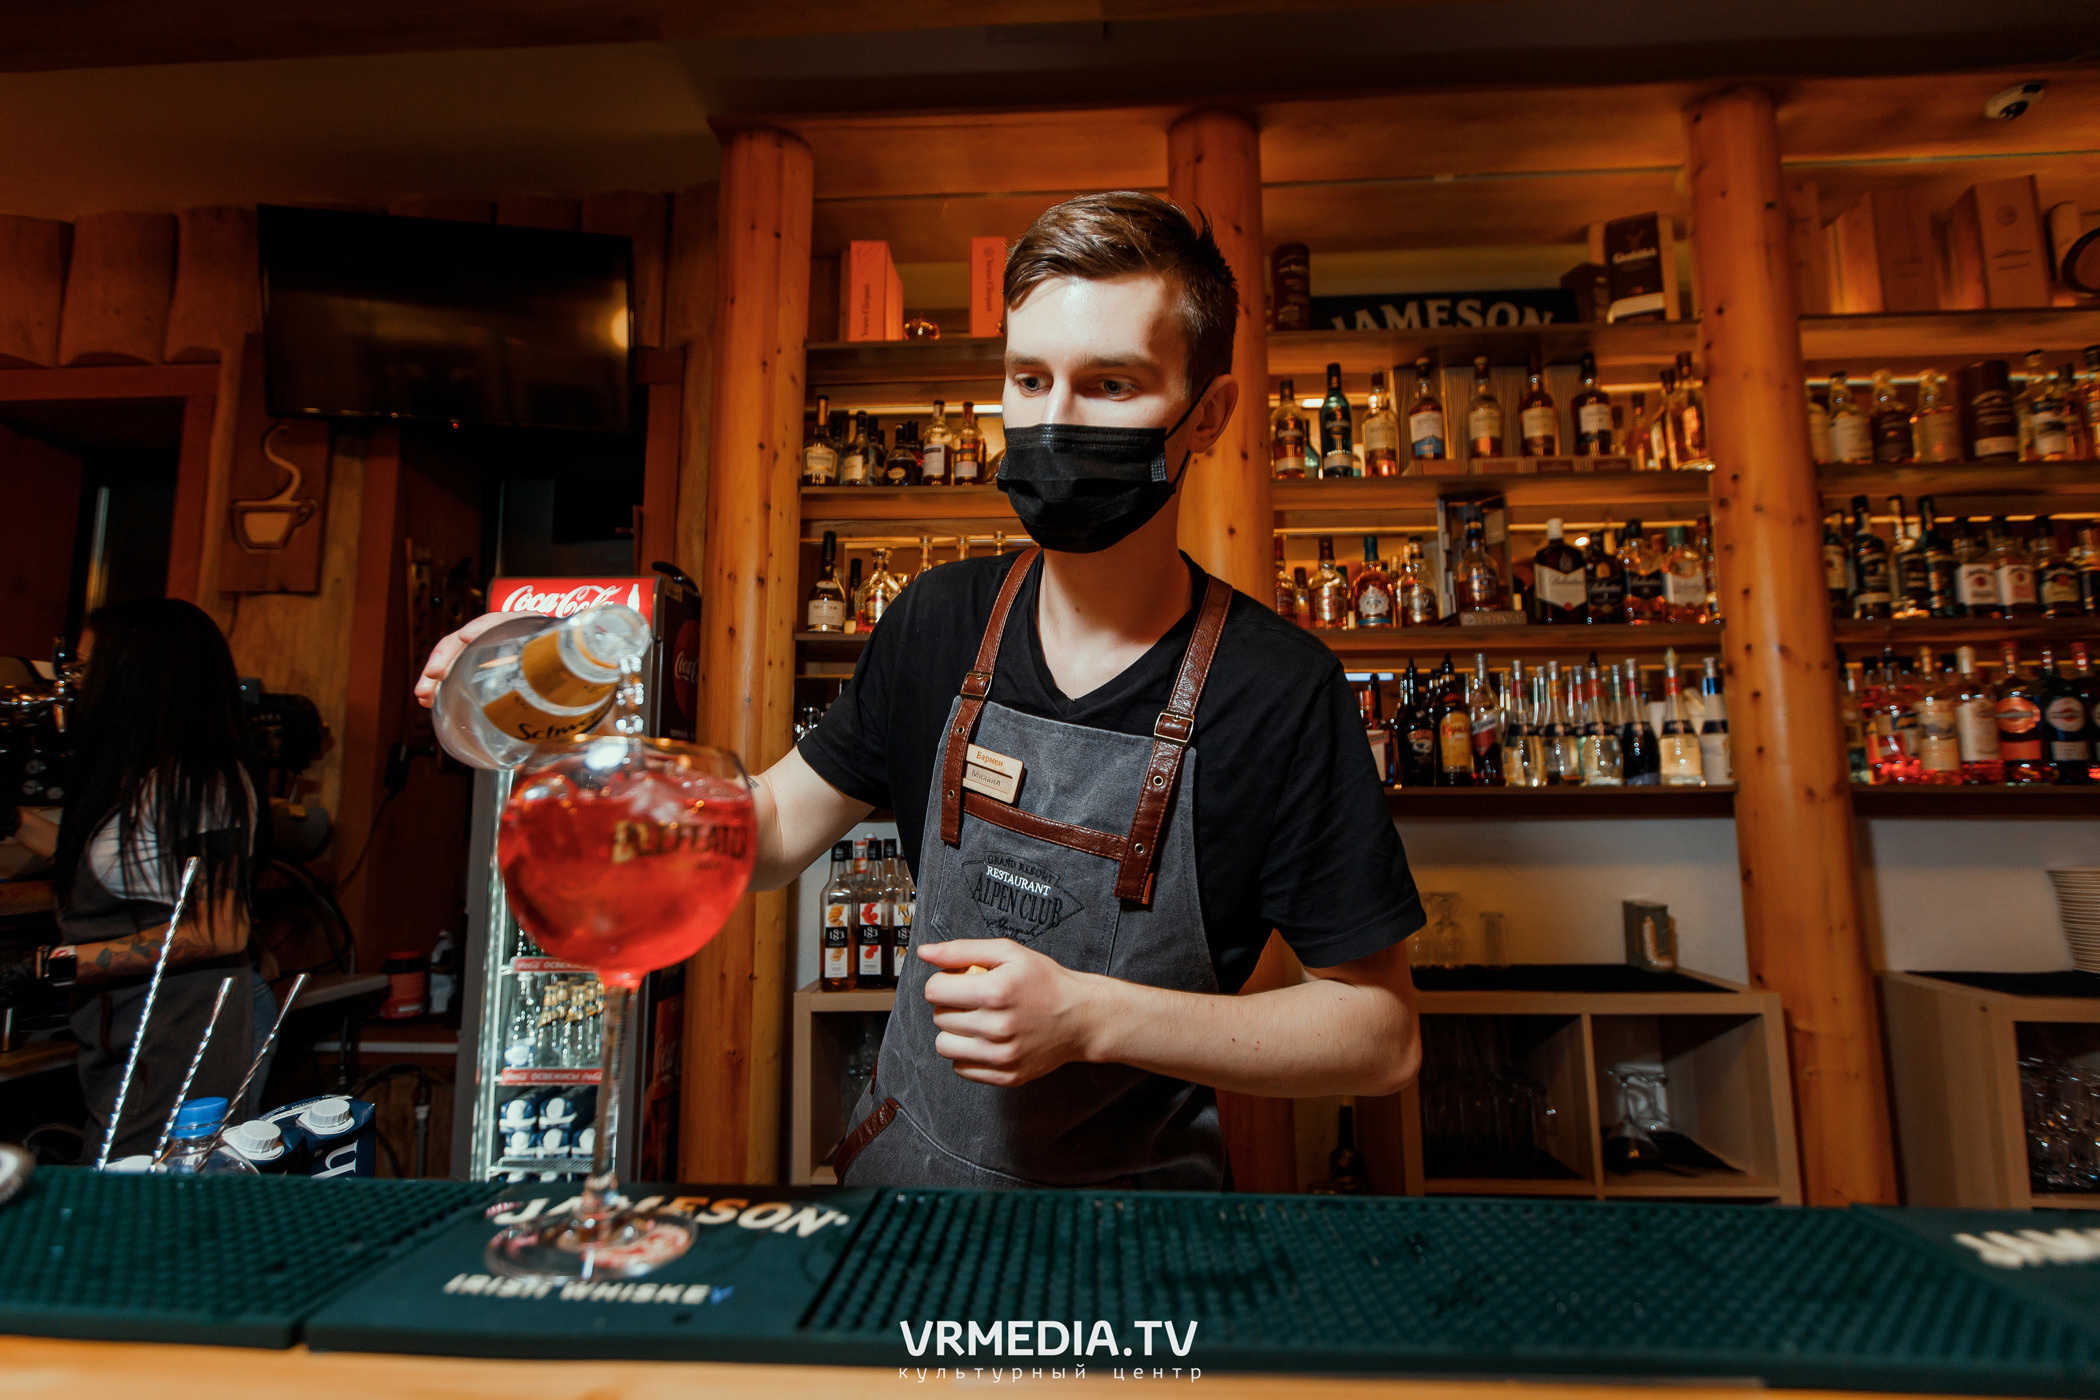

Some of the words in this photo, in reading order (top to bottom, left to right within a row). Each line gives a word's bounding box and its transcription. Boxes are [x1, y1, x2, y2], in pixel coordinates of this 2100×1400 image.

[976, 751, 1004, 768] Бармен
[971, 769, 1001, 786] Михаил
[986, 865, 1051, 896] RESTAURANT
[987, 854, 1017, 869] GRAND
[1018, 862, 1055, 884] RESORT
[971, 871, 1020, 916] ALPEN
[1020, 893, 1064, 928] CLUB
